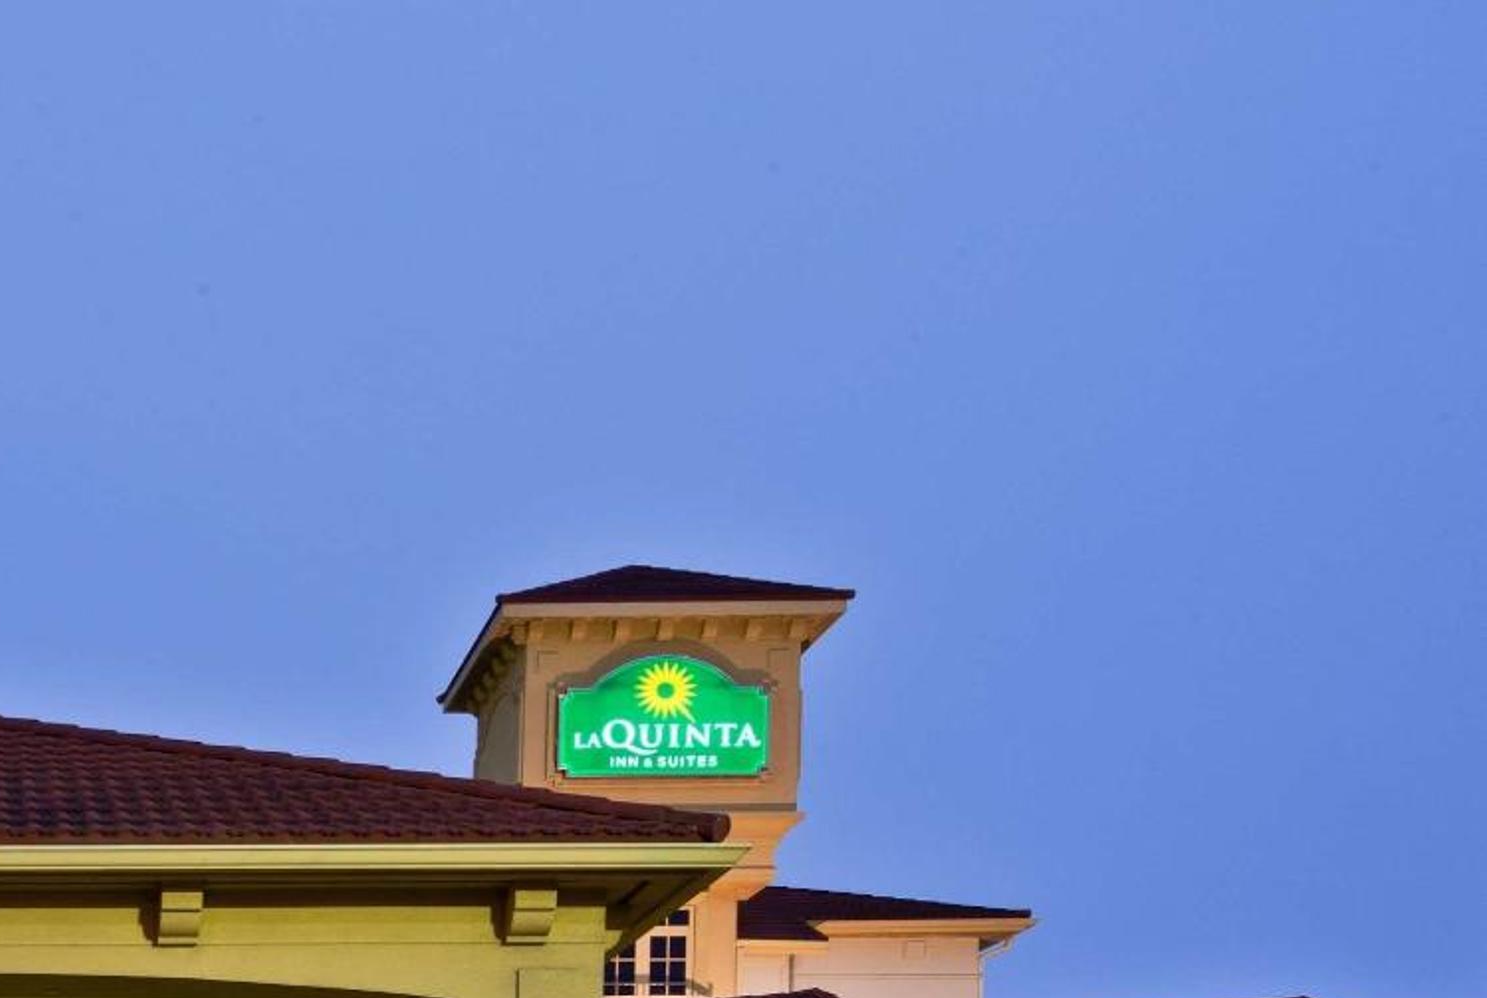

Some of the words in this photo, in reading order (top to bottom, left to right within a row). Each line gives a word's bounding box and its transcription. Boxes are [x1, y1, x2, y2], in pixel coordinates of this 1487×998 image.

[573, 731, 602, 749] LA
[601, 718, 762, 756] QUINTA
[609, 755, 639, 768] INN
[643, 756, 653, 768] &
[657, 755, 718, 768] SUITES
